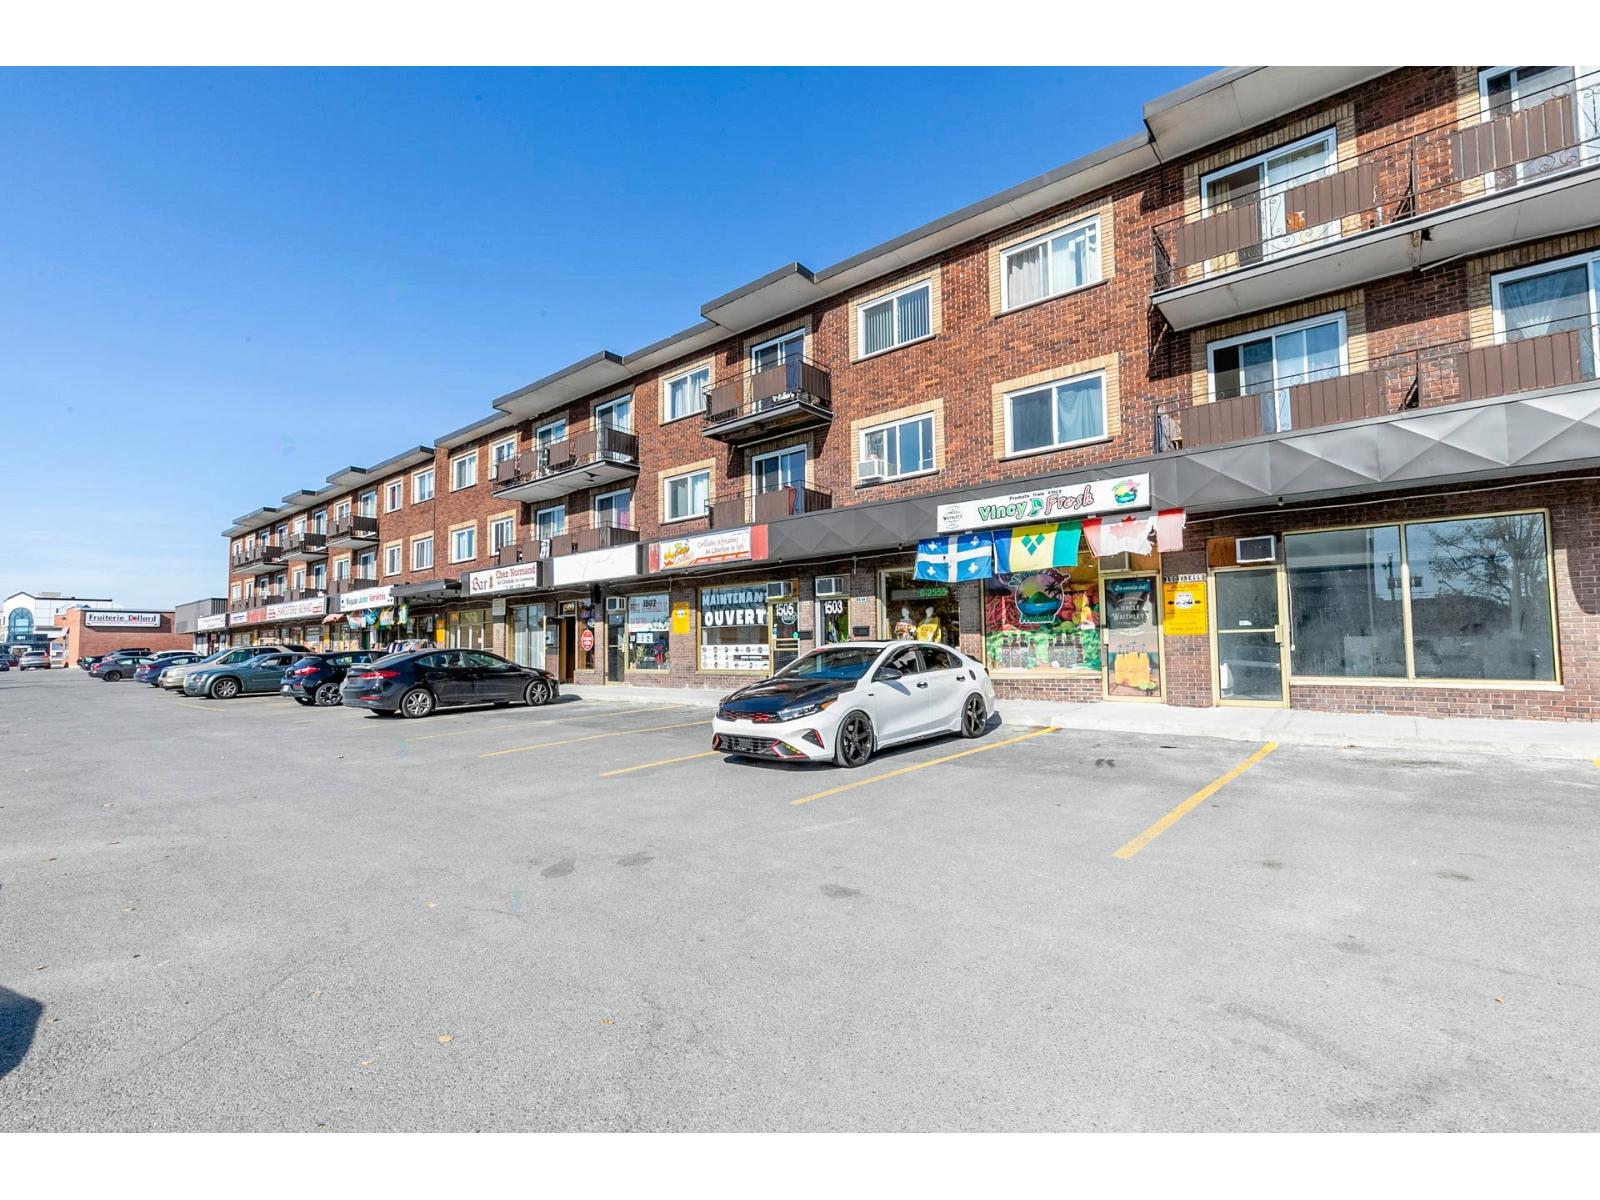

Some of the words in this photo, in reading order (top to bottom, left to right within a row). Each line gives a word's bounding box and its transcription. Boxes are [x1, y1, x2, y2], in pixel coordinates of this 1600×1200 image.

[977, 501, 1028, 521] Vincy
[1044, 484, 1095, 516] Fresh
[495, 570, 509, 579] Chez
[510, 564, 536, 577] Normand
[472, 577, 488, 591] Bar
[642, 599, 657, 607] 1507
[775, 602, 794, 616] 1505
[824, 600, 843, 614] 1503
[89, 613, 125, 621] Fruiterie
[128, 614, 157, 622] Dollard
[704, 608, 767, 626] OUVERT
